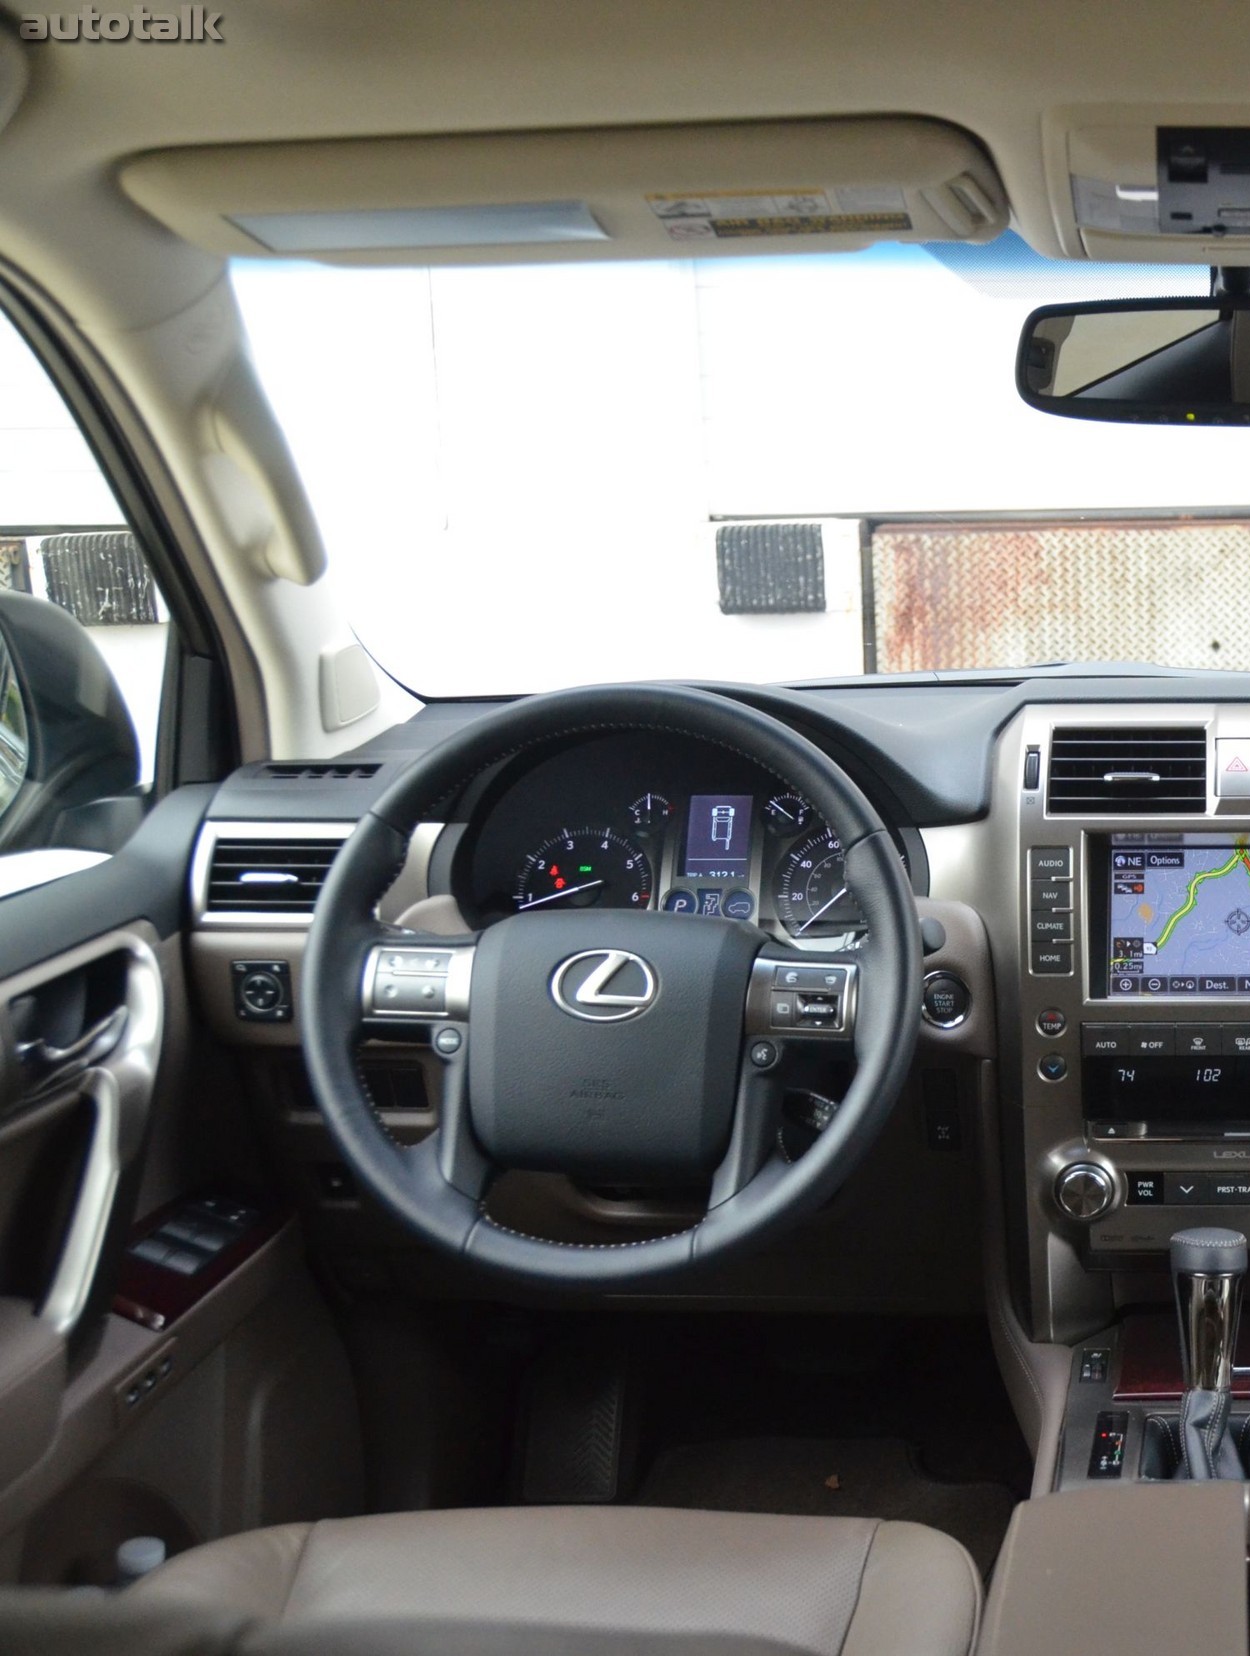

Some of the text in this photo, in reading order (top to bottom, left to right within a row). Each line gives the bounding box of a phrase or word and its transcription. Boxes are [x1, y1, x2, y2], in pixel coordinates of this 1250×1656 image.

[566, 841, 574, 850] 3
[600, 841, 609, 850] 4
[827, 841, 840, 849] 60
[538, 860, 546, 869] 2
[626, 860, 634, 869] 5
[800, 860, 812, 869] 40
[1038, 860, 1064, 868] AUDIO
[1127, 856, 1142, 866] NE
[1150, 855, 1181, 867] Options
[527, 893, 533, 902] 1
[631, 893, 639, 901] 6
[791, 893, 804, 901] 20
[1042, 891, 1059, 900] NAV
[1036, 922, 1064, 931] CLIMATE
[1039, 954, 1061, 962] HOME
[1205, 980, 1229, 990] Dest.
[1043, 1022, 1062, 1030] TEMP
[1095, 1041, 1117, 1049] AUTO
[1148, 1041, 1164, 1049] OFF
[1118, 1069, 1135, 1082] 74
[1196, 1068, 1222, 1082] 102
[1137, 1189, 1153, 1197] VOL
